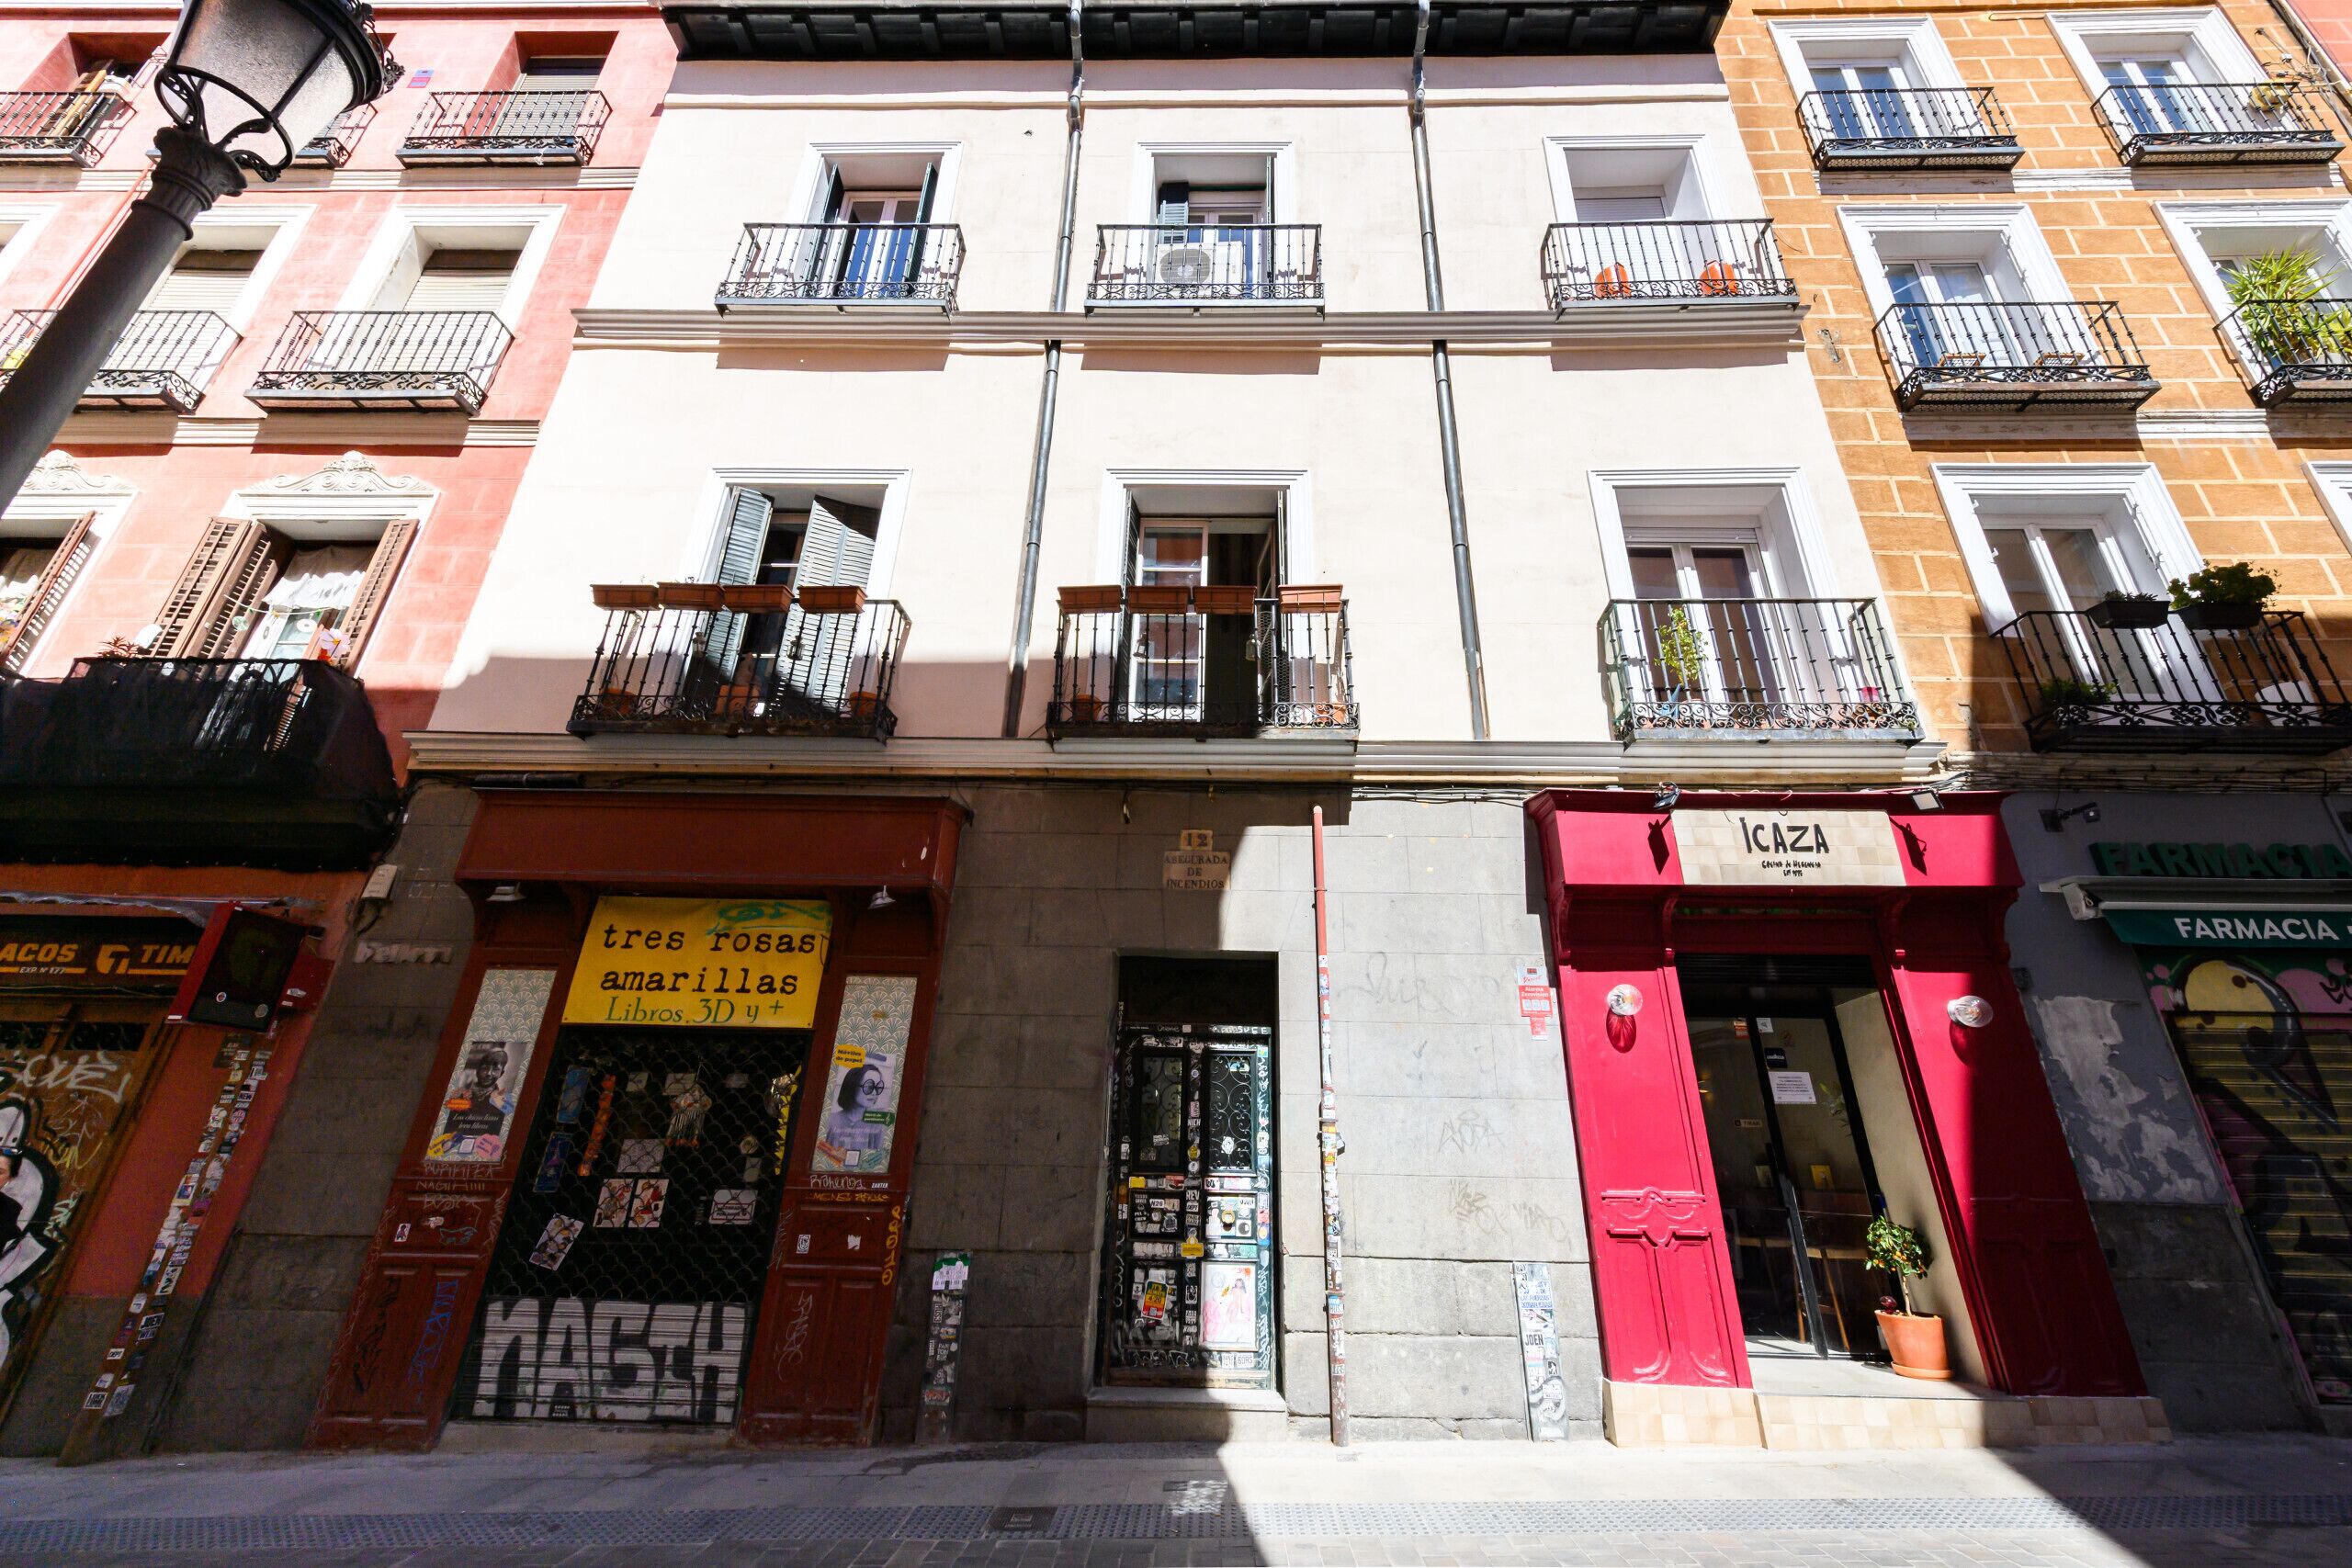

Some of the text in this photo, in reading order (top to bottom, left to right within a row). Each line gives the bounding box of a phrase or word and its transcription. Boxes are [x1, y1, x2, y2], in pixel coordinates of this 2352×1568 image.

[1186, 833, 1207, 847] 12
[2089, 842, 2352, 877] FARMACIA
[1187, 867, 1202, 876] DE
[1166, 879, 1225, 889] INCENDIOS
[603, 923, 816, 954] tres rosas
[2174, 918, 2340, 941] FARMACIA
[139, 944, 197, 964] TIM
[600, 966, 798, 995] amarillas
[604, 995, 684, 1023] Libros
[692, 998, 735, 1024] 3D
[745, 1007, 760, 1023] y
[1524, 1334, 1544, 1346] JOEN
